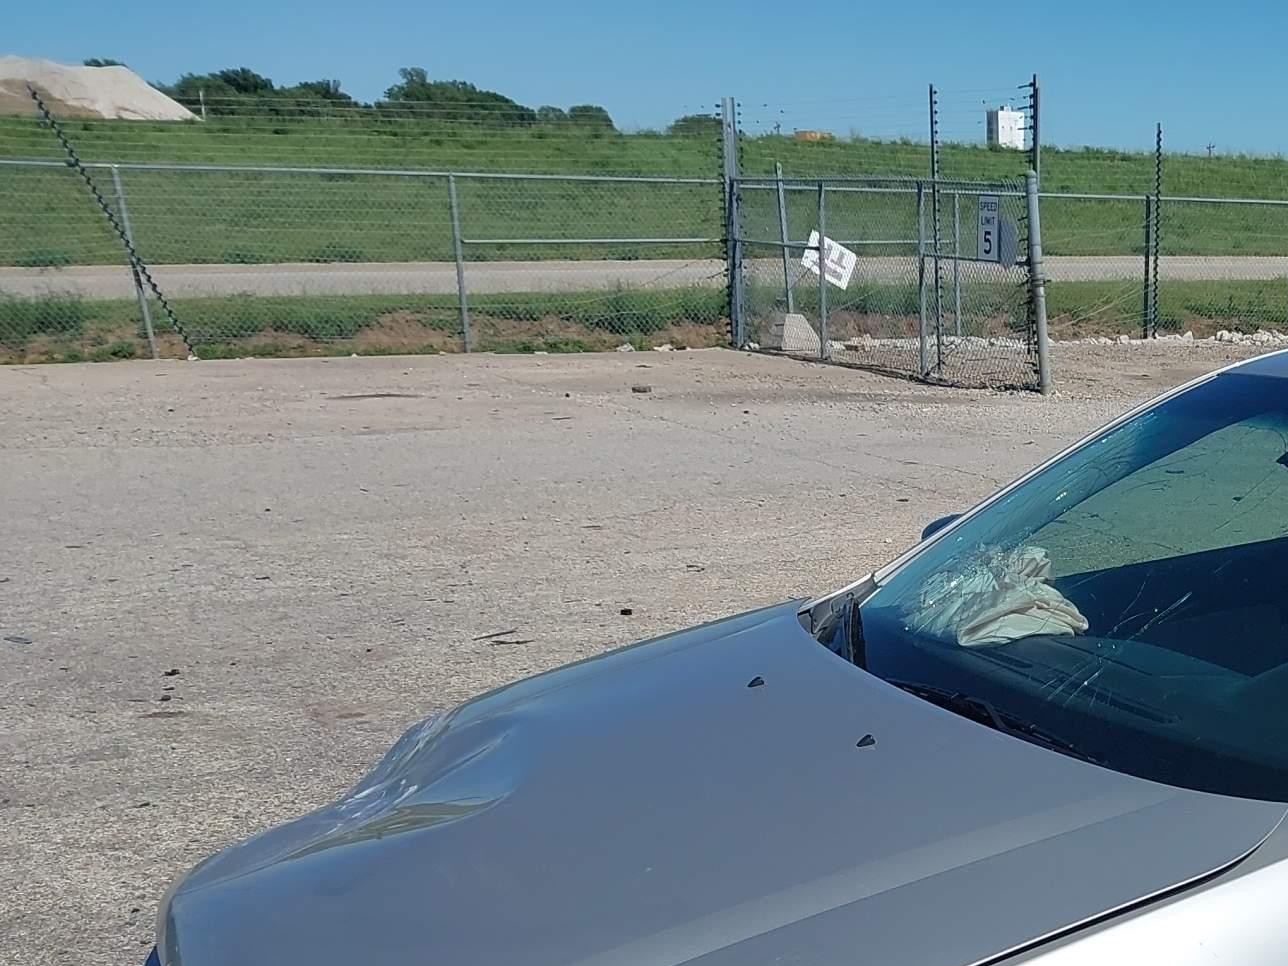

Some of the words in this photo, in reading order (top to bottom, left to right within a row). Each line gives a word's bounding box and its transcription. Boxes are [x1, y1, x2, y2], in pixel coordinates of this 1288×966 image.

[980, 201, 997, 212] SPEED
[981, 215, 995, 226] LIMIT
[983, 230, 992, 255] 5
